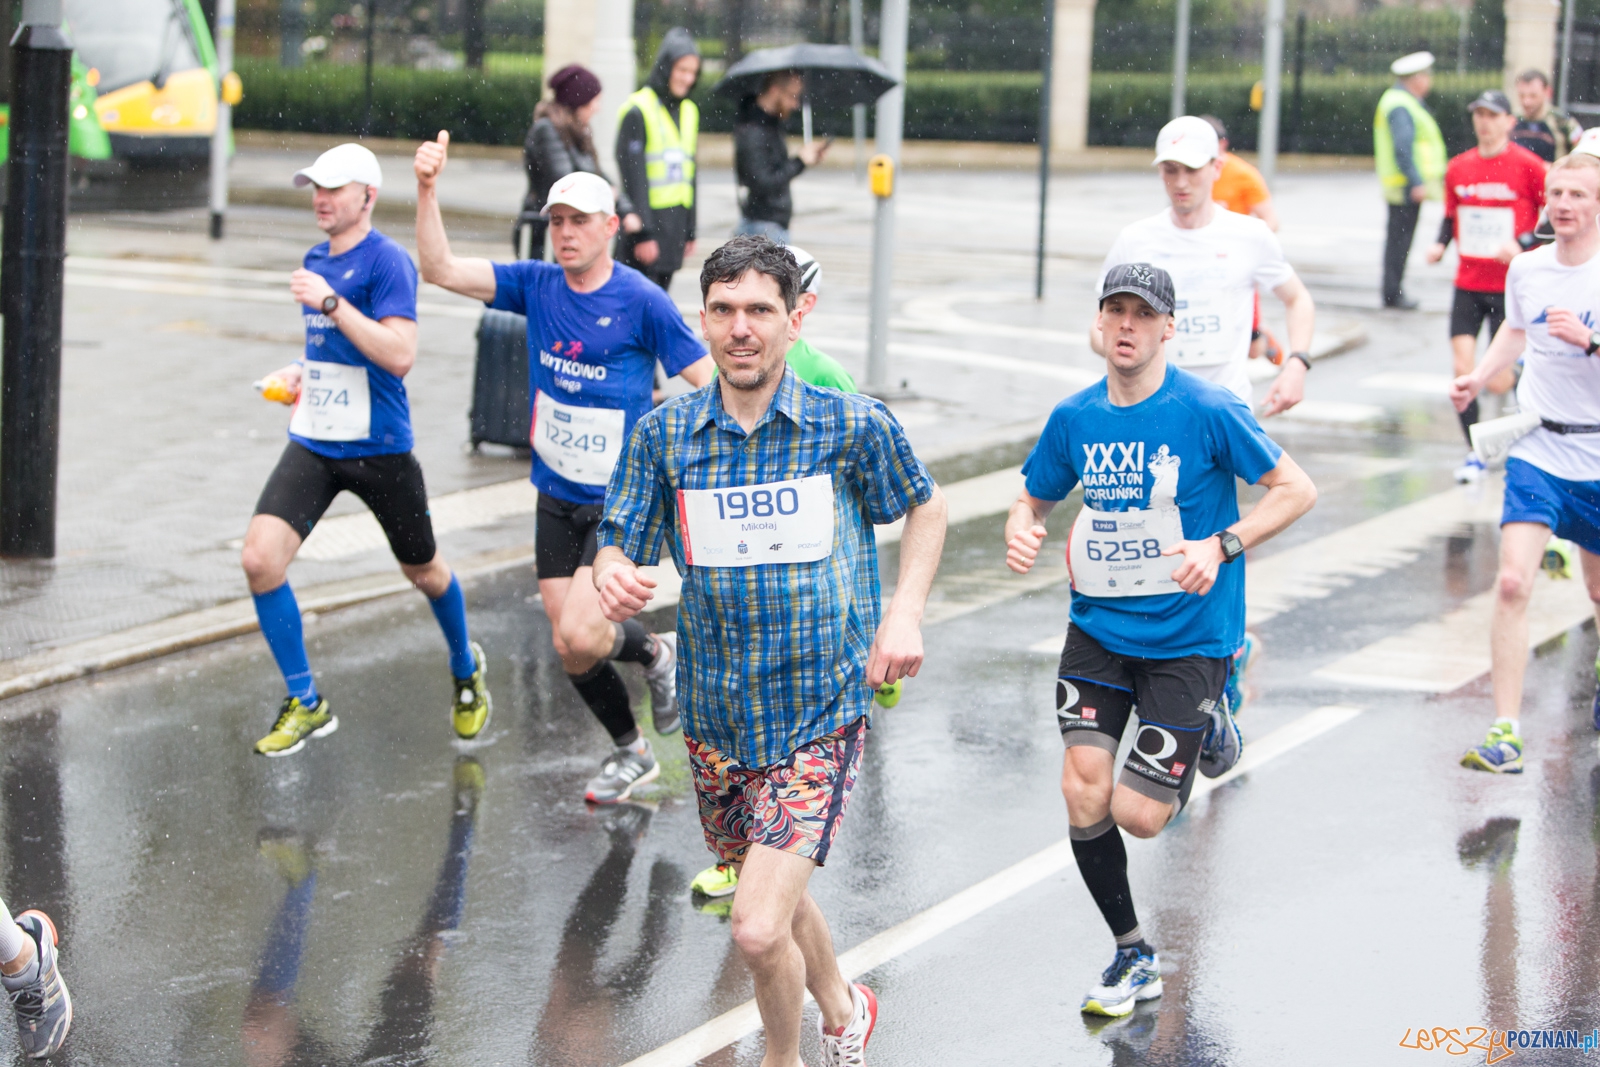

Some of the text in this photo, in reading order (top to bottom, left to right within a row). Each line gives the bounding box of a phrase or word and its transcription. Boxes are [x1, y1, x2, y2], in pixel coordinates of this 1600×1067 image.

[545, 420, 607, 453] 12249
[1082, 441, 1145, 473] XXXI
[1083, 472, 1143, 486] MARATON
[713, 487, 799, 520] 1980
[741, 521, 777, 532] Mikołaj
[1086, 538, 1161, 562] 6258
[1132, 725, 1178, 773] Q
